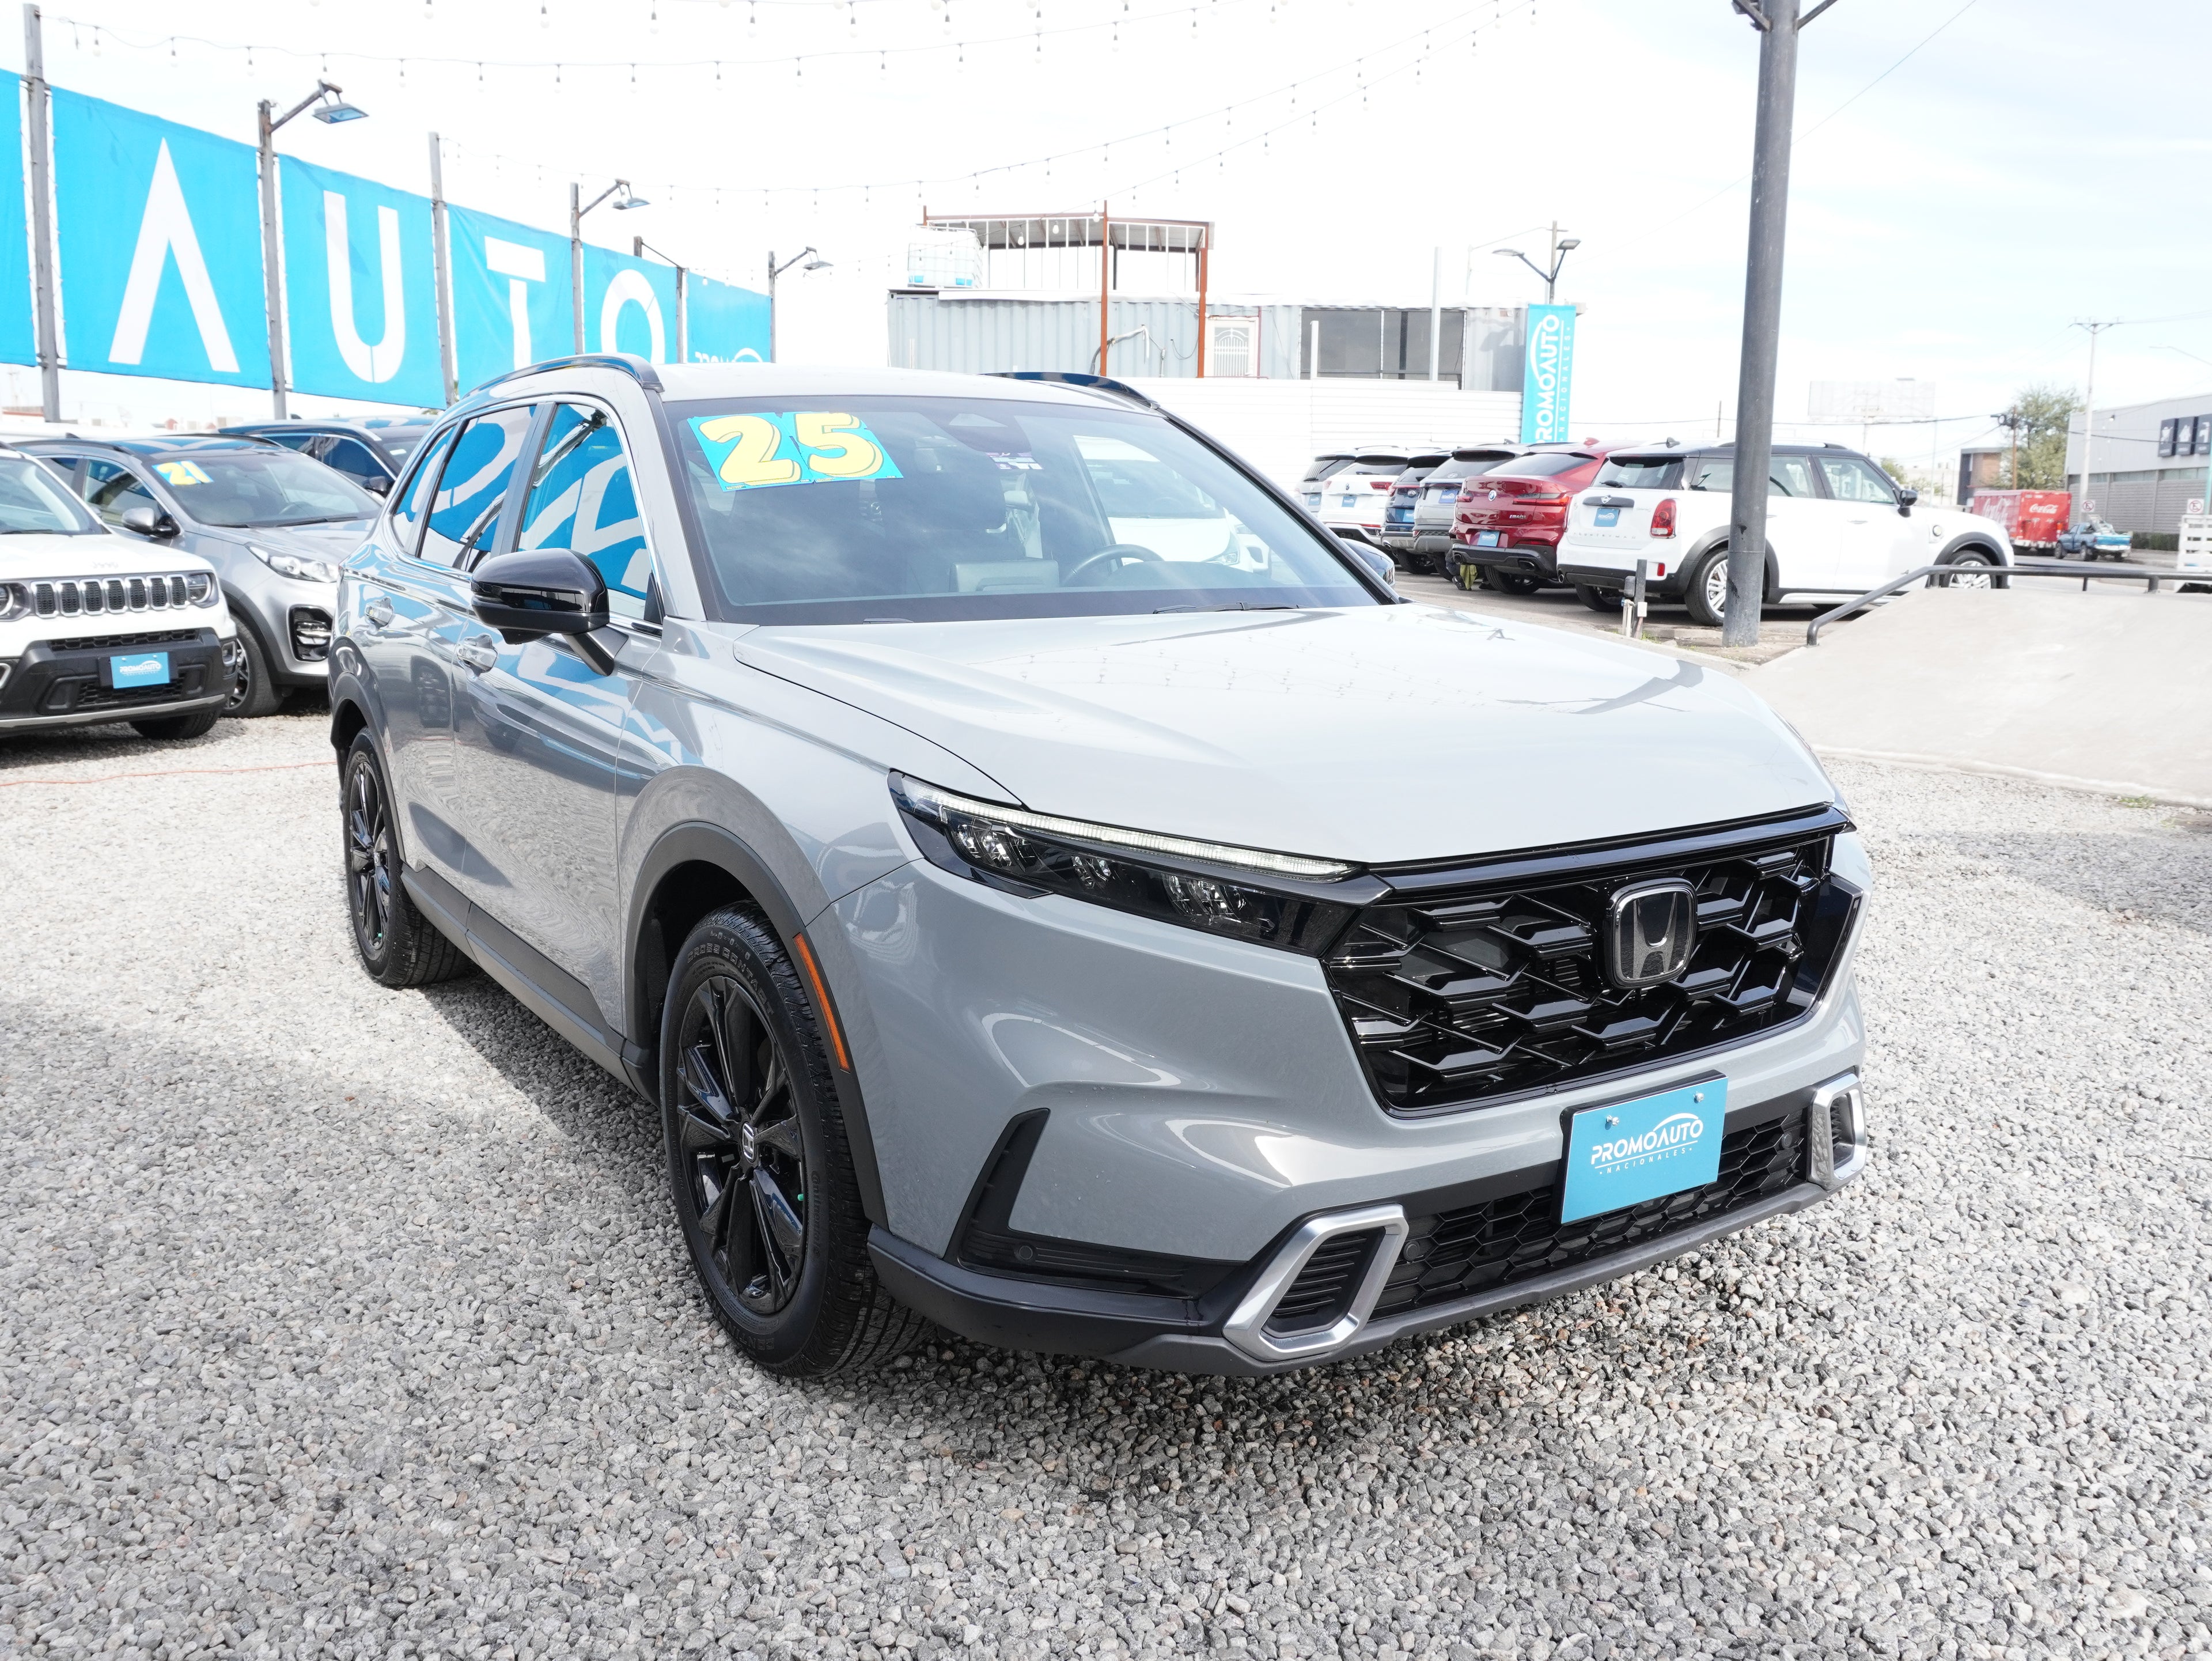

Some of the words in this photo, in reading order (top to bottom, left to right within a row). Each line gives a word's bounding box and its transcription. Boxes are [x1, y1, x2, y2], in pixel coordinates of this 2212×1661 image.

[1535, 314, 1560, 443] ROMOAUTO
[1558, 335, 1571, 432] NACIONALES
[699, 413, 884, 485] 25
[156, 460, 211, 485] 21
[2029, 504, 2059, 514] Coca-Cola
[119, 663, 162, 673] PROMOAUTO
[1590, 1119, 1704, 1165] PROMOAUTO
[1606, 1147, 1686, 1174] NACIONALES
